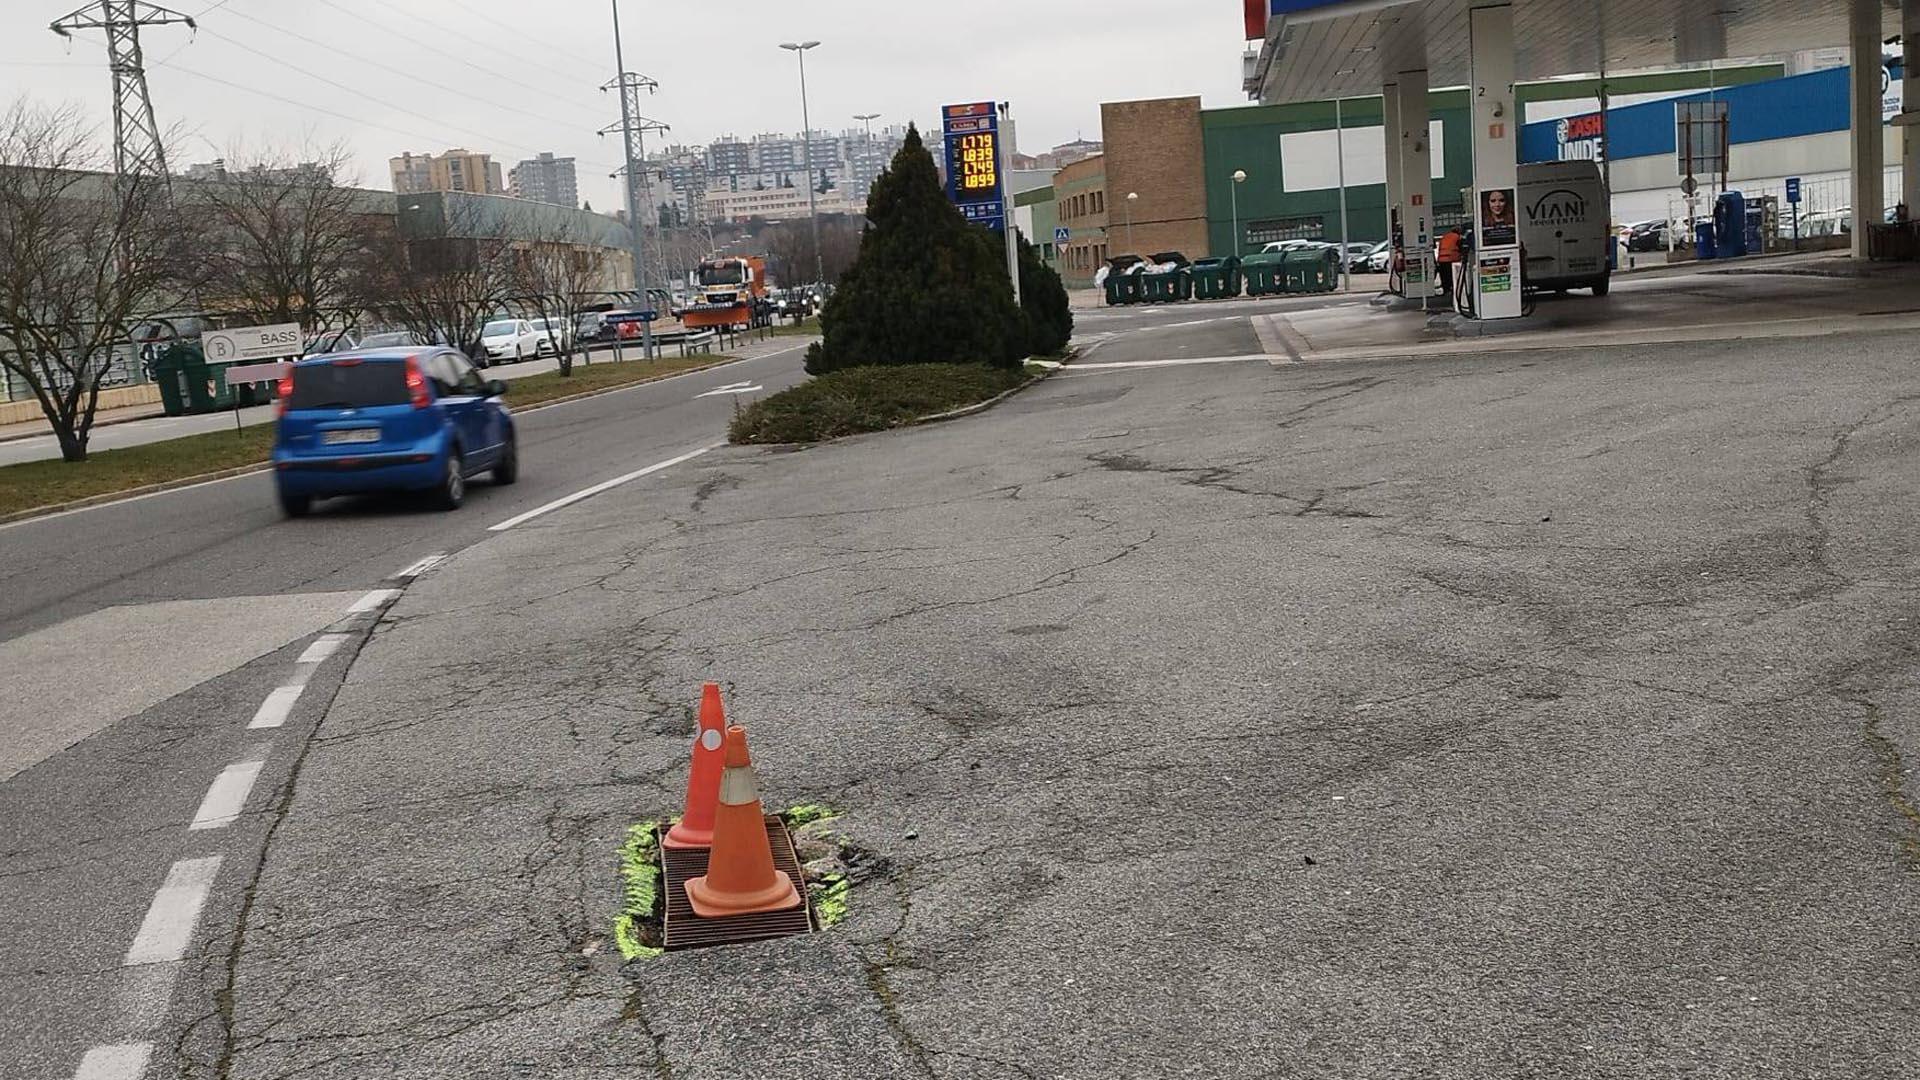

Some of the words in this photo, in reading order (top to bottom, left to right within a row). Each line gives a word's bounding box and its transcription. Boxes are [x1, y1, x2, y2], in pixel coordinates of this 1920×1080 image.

[1478, 86, 1485, 96] 2
[1568, 114, 1603, 139] CASH
[1557, 138, 1603, 162] UNIDE
[1525, 198, 1585, 219] VIANI
[260, 331, 297, 345] BASS
[215, 342, 226, 356] B
